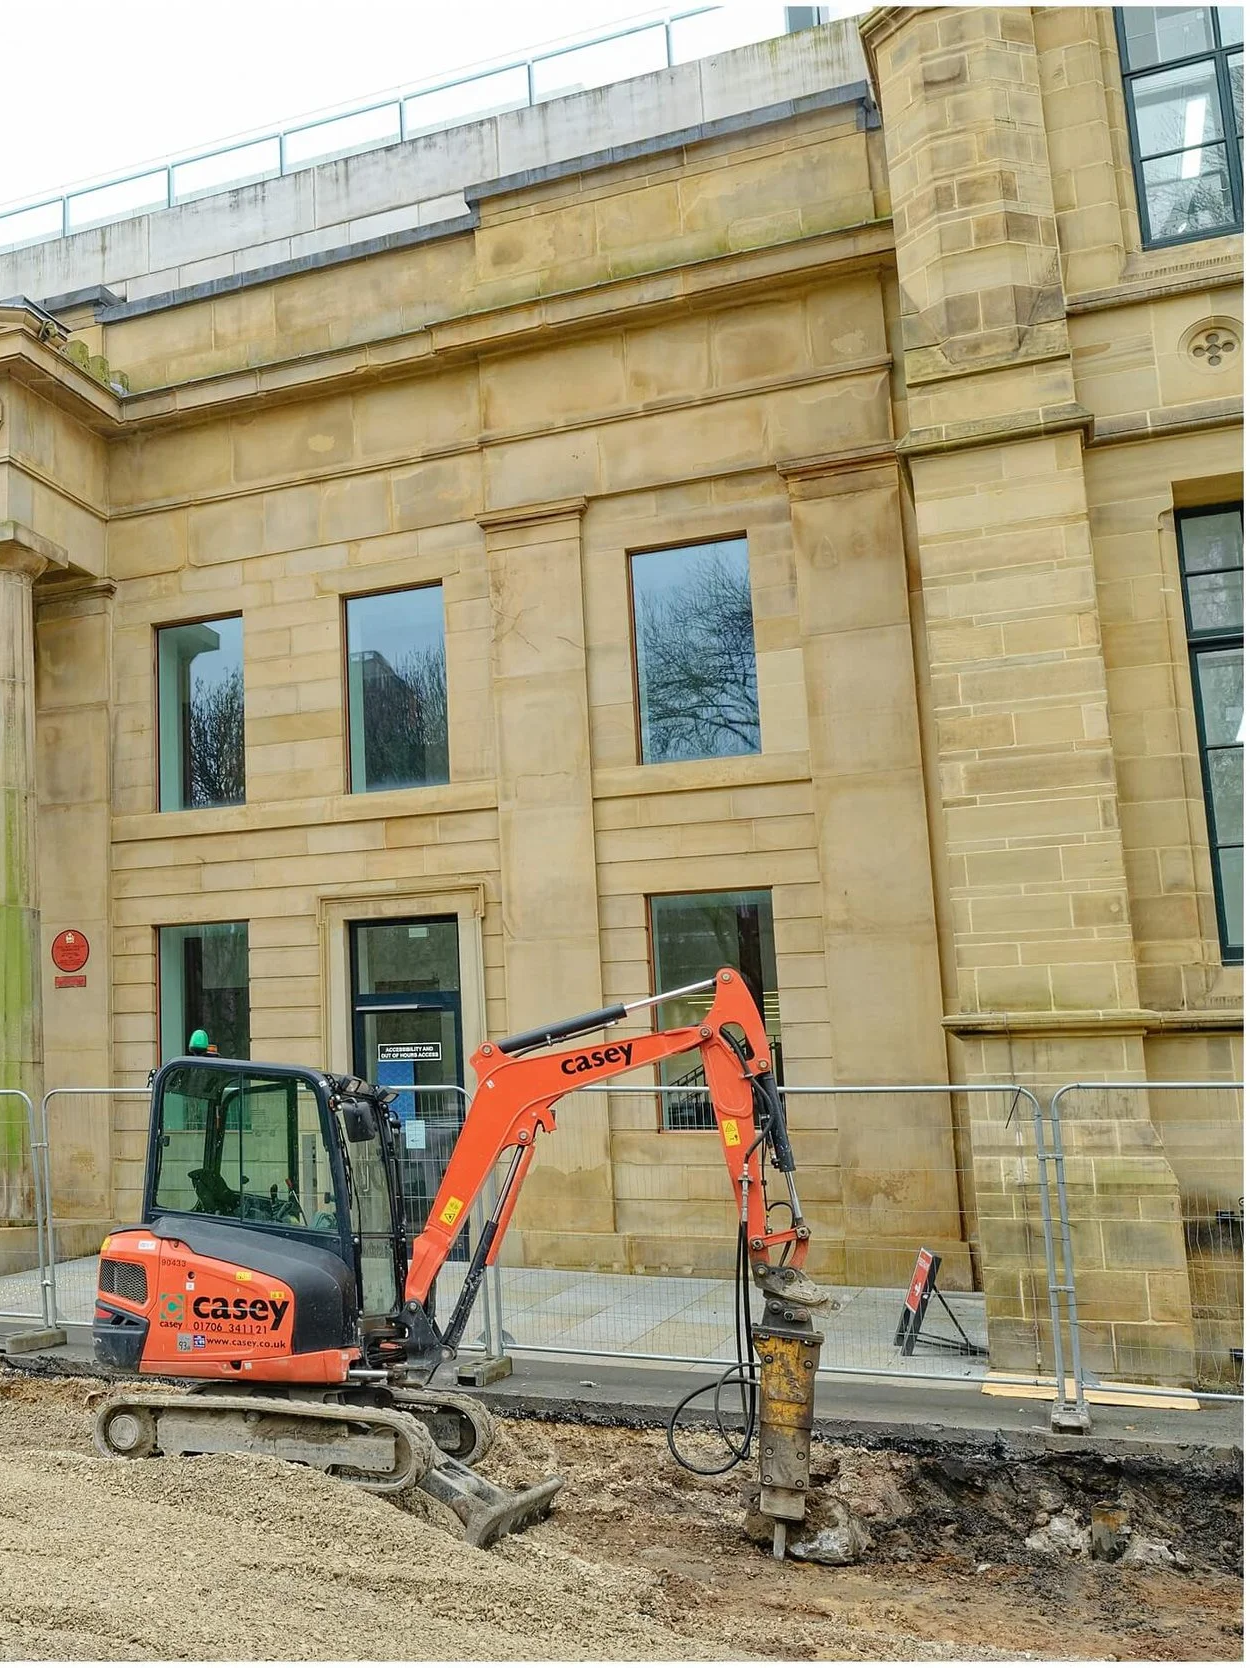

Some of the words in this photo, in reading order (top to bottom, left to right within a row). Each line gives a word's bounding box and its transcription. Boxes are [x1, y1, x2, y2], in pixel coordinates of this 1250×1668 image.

[561, 1043, 633, 1075] casey
[161, 1259, 187, 1267] 90433
[193, 1296, 290, 1331] casey
[159, 1321, 183, 1330] casey
[193, 1321, 223, 1332] 01706
[228, 1323, 267, 1335] 341121
[206, 1338, 286, 1349] www.casey.co.uk
